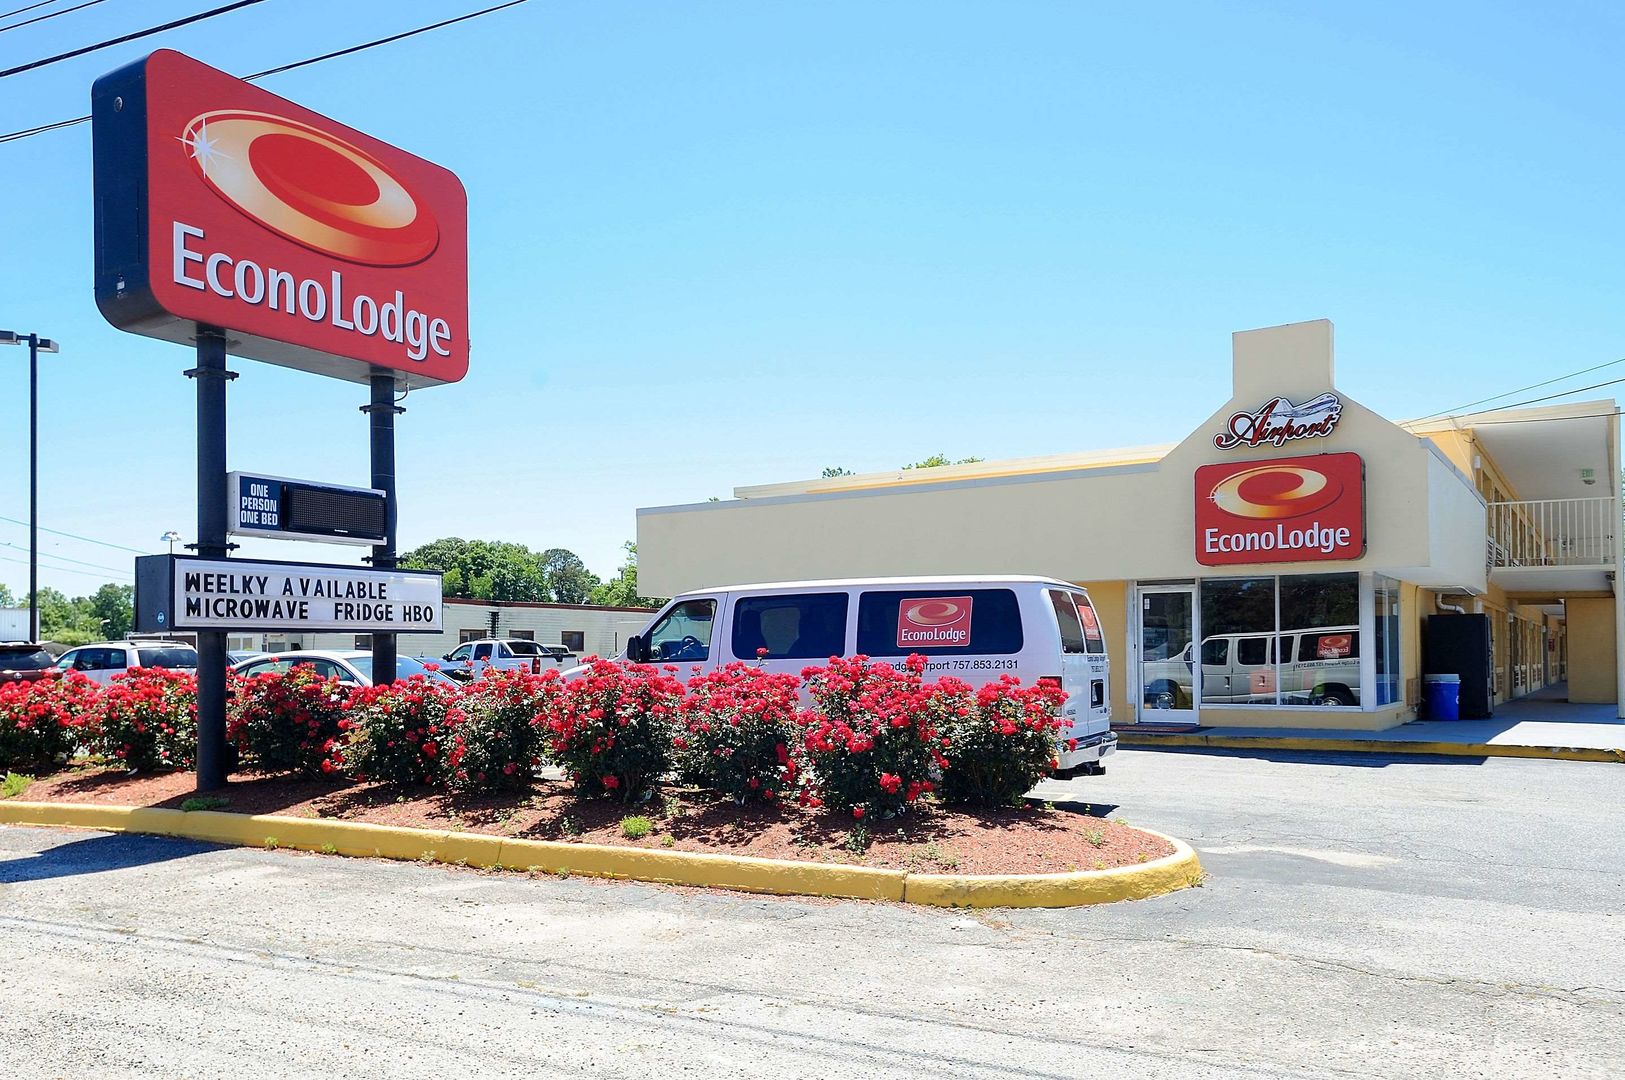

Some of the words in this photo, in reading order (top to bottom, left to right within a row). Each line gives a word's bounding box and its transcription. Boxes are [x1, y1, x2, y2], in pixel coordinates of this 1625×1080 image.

[172, 219, 452, 361] EconoLodge
[1214, 398, 1336, 448] Airport
[250, 483, 269, 498] ONE
[241, 496, 277, 512] PERSON
[240, 510, 259, 524] ONE
[261, 512, 278, 526] BED
[1204, 521, 1350, 553] EconoLodge
[185, 572, 269, 595] WEELKY
[282, 577, 387, 600] AVAILABLE
[185, 597, 309, 620] MICROWAVE
[403, 605, 433, 623] HBO
[901, 627, 966, 643] EconoLodge
[952, 659, 1019, 670] 757.853.2131
